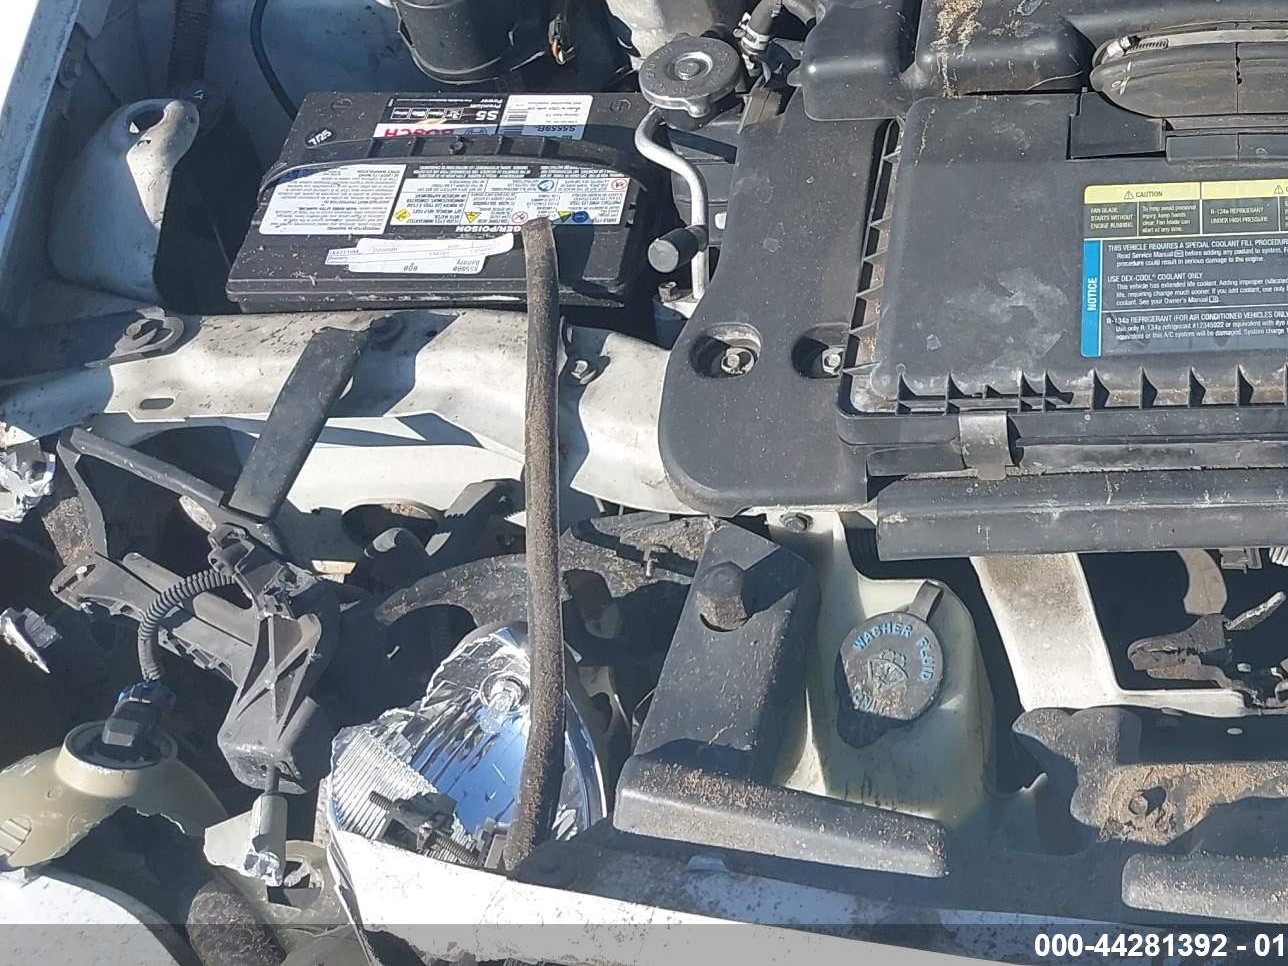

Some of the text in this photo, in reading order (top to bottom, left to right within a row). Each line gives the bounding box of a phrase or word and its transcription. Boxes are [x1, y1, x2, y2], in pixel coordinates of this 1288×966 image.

[475, 110, 499, 120] S5
[307, 129, 332, 146] 7/25
[455, 223, 520, 233] GER/POISON
[1122, 243, 1147, 251] VEHICLE
[1148, 242, 1177, 250] REQUIRES
[1185, 240, 1209, 248] SPECIAL
[1211, 239, 1238, 247] COOLANT
[1203, 248, 1221, 256] adding
[1205, 256, 1227, 264] damage
[1157, 272, 1185, 280] COOLANT
[1188, 271, 1203, 279] ONLY
[1238, 278, 1263, 286] improper
[1274, 285, 1284, 293] only
[1087, 277, 1097, 311] NOTICE
[1130, 315, 1171, 323] REFRIGERANT
[1201, 312, 1242, 320] CONDITIONED
[1244, 311, 1272, 319] VEHICLES
[1162, 323, 1192, 331] refrigerant
[1265, 327, 1284, 335] charge
